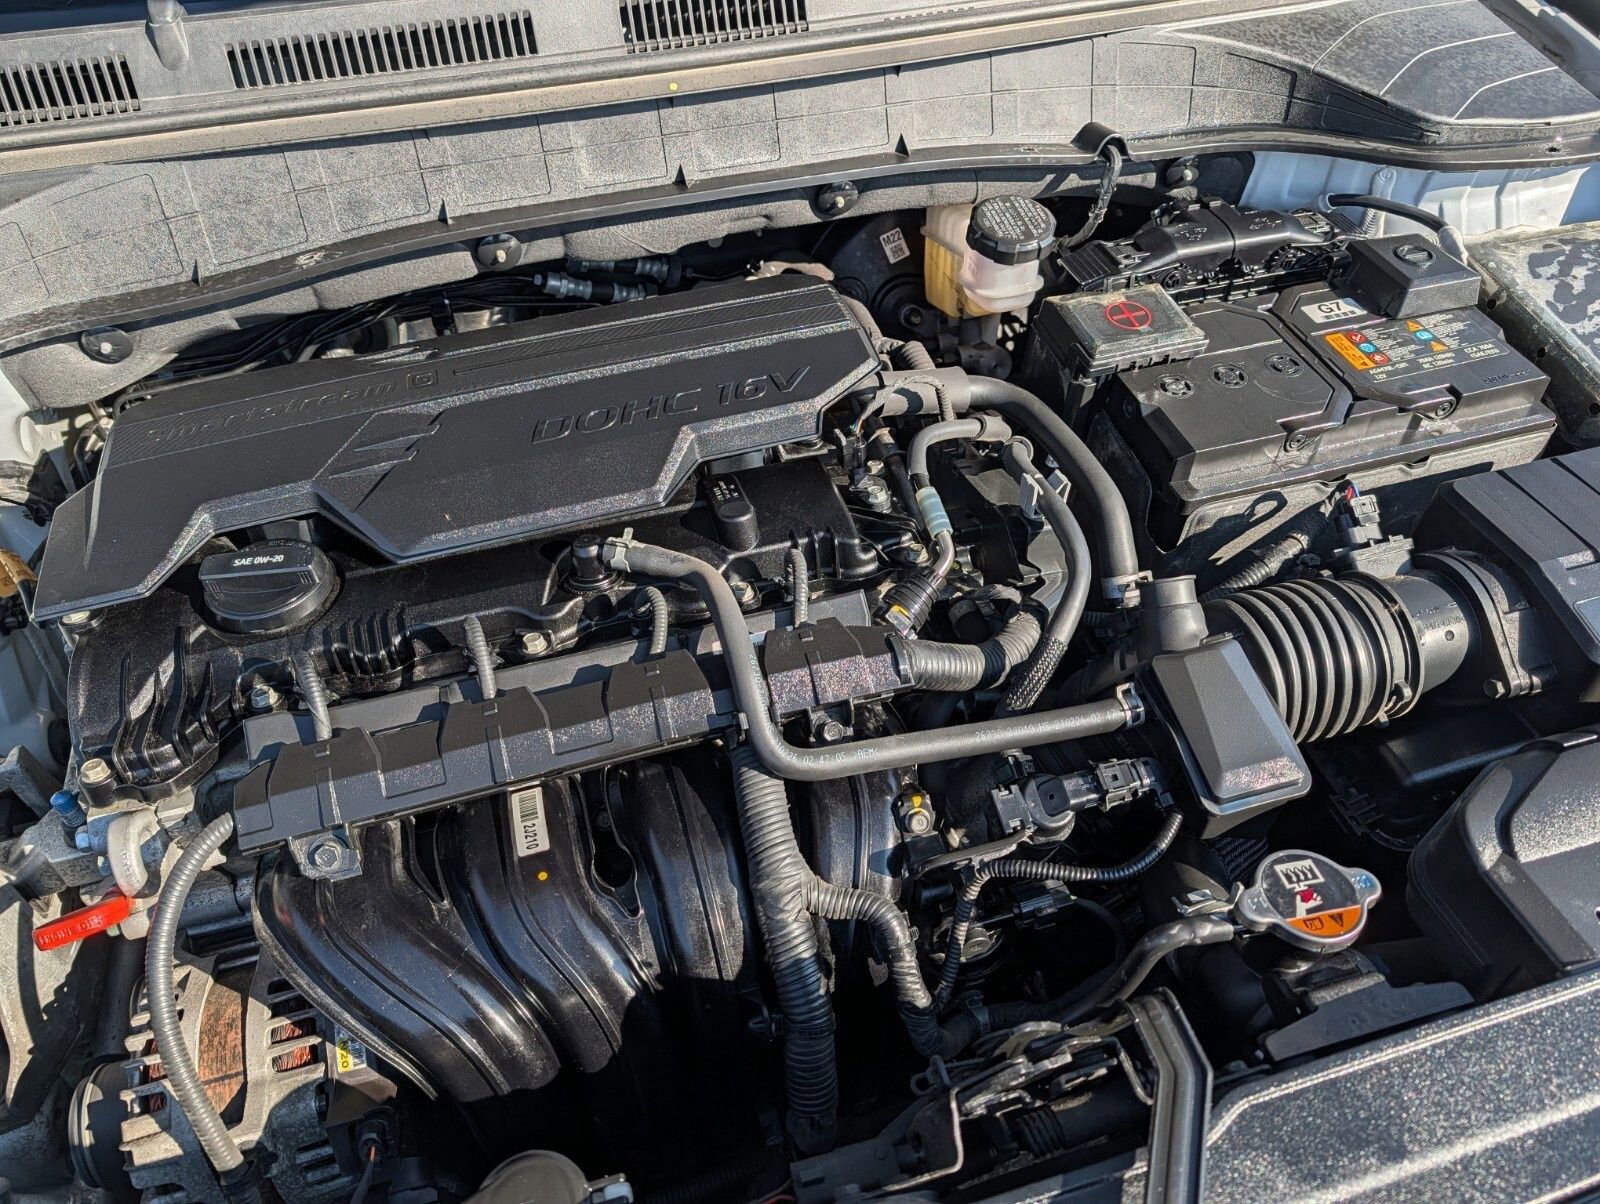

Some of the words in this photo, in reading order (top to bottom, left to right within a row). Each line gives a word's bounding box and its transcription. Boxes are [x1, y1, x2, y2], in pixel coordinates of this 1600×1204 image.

[882, 230, 903, 248] M22
[1317, 301, 1343, 314] G7
[531, 387, 702, 445] DOHC
[715, 365, 811, 406] 16V
[233, 557, 253, 567] SAE
[253, 554, 285, 564] 0W-20
[523, 822, 540, 850] 2J210
